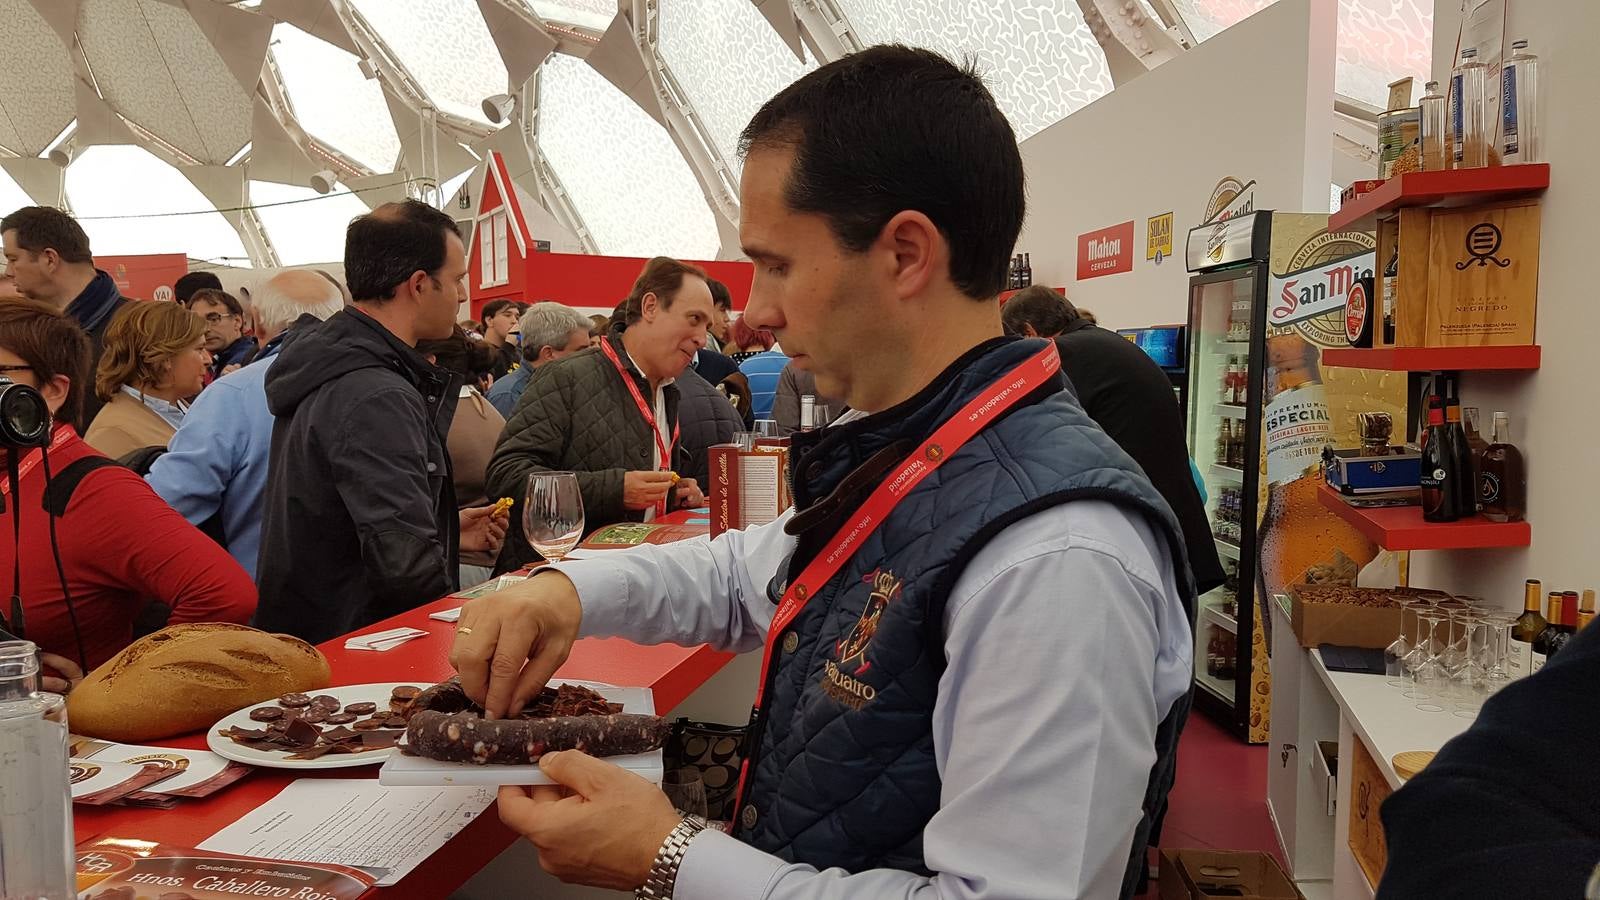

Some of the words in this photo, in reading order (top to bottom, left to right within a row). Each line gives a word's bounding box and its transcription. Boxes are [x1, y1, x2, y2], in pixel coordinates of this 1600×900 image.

[1088, 236, 1121, 262] Mahou
[1293, 244, 1318, 270] CERVEZA
[1317, 232, 1374, 248] INTERNACIONAL
[1091, 260, 1117, 272] CERVEZAS
[1272, 279, 1326, 319] San
[1456, 304, 1508, 313] NEGREDO
[1301, 321, 1336, 343] EXPLORING
[969, 377, 1027, 422] info.valladolid.es
[1273, 402, 1320, 416] PREMIUM
[1266, 409, 1330, 432] ESPECIAL
[718, 452, 729, 486] Castilla
[888, 460, 924, 493] Valladolid
[719, 488, 728, 498] de
[720, 499, 729, 530] Selectos
[826, 515, 872, 564] info.valladolid.es
[126, 872, 184, 889] Hnos.
[192, 876, 291, 898] Caballero
